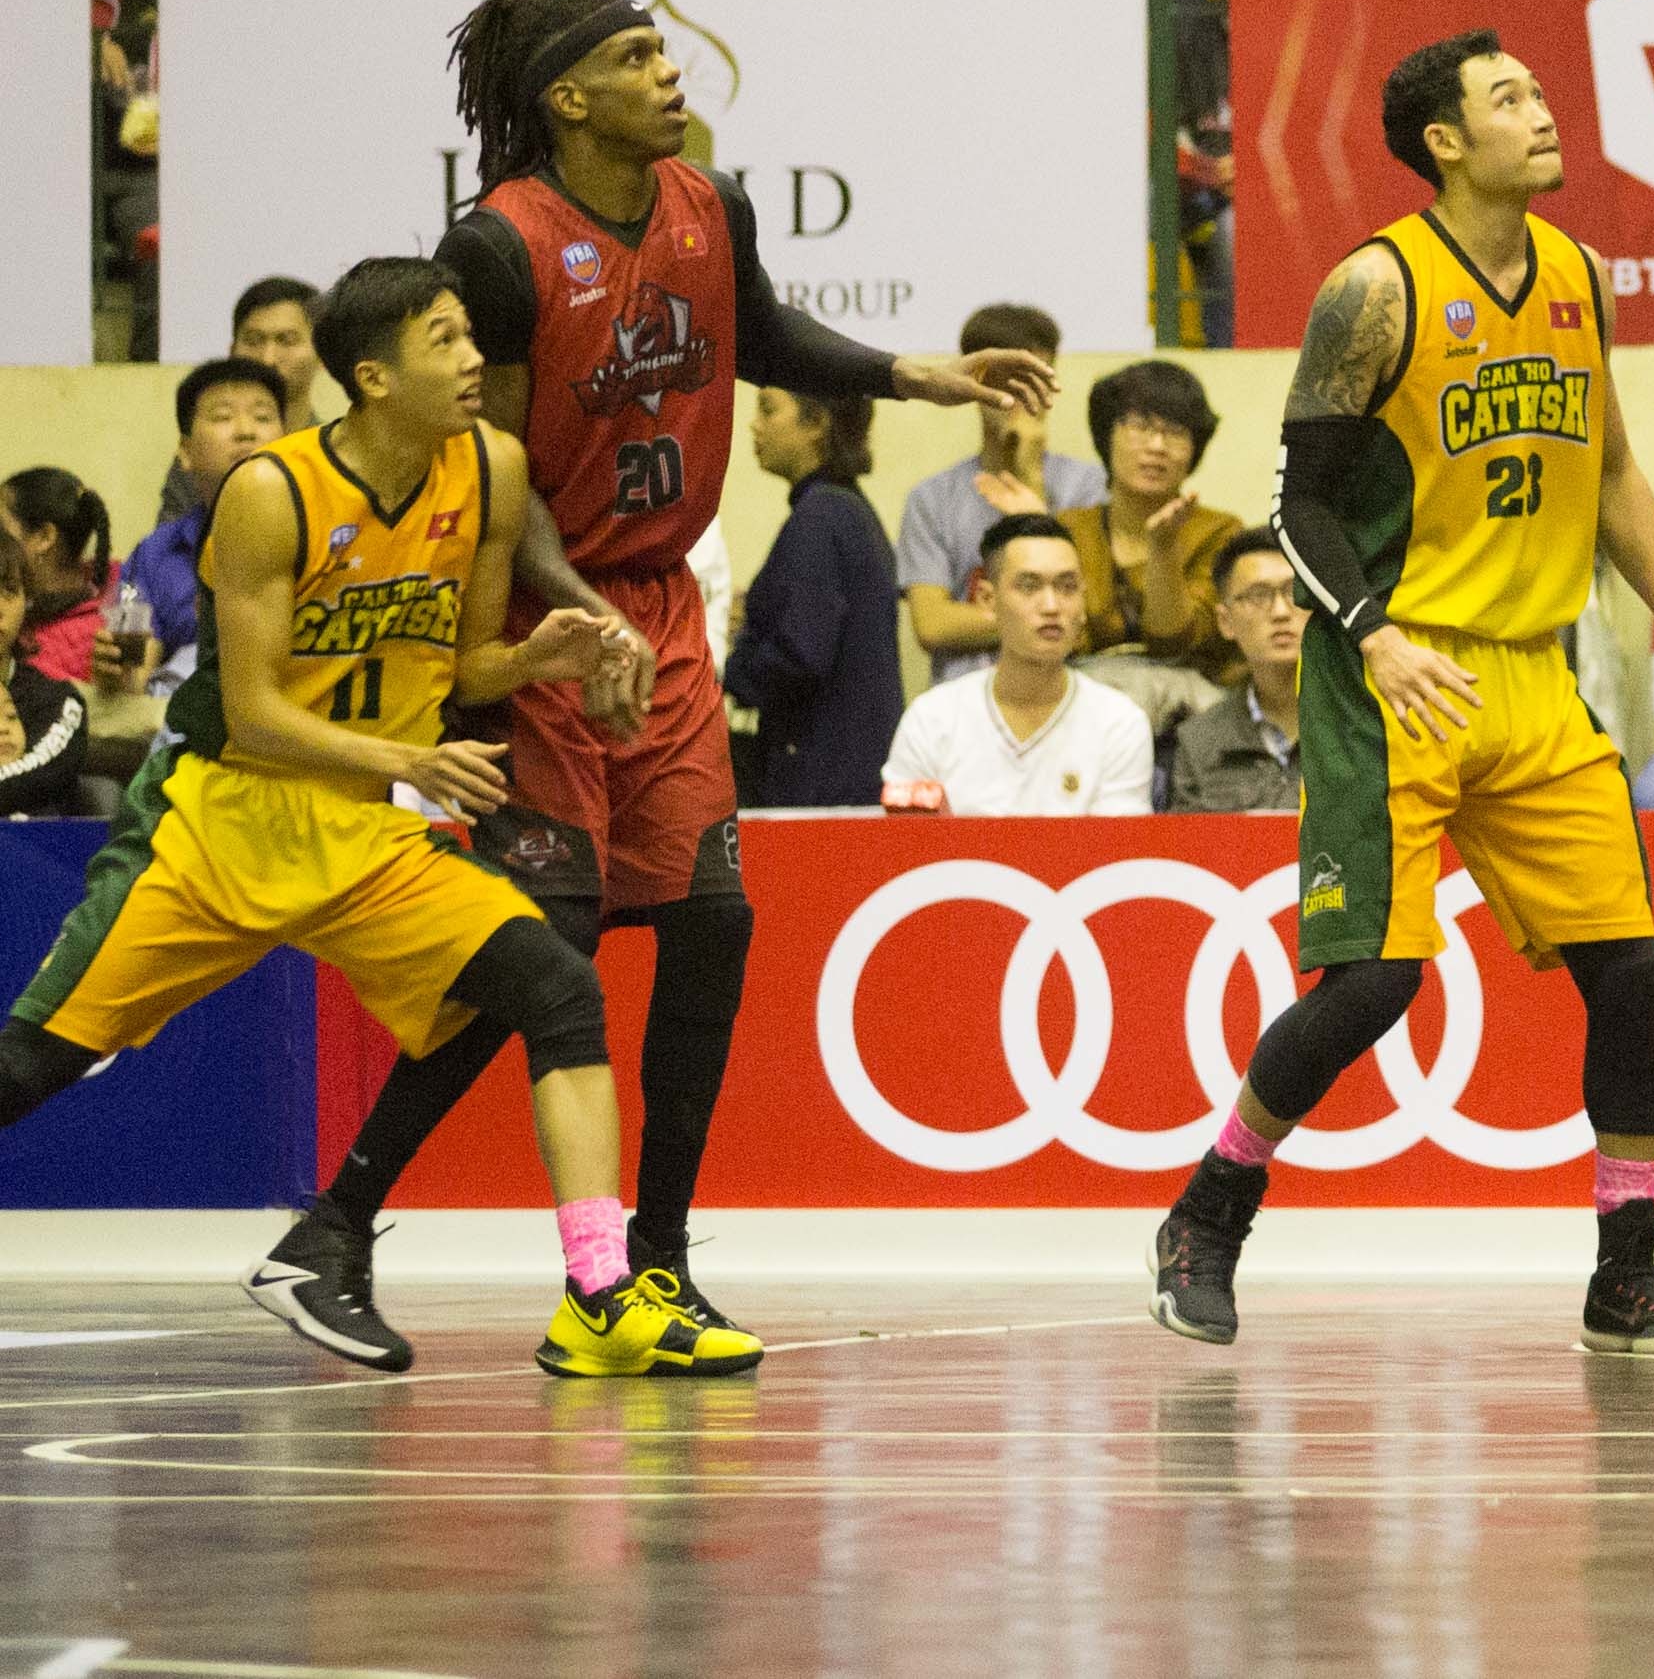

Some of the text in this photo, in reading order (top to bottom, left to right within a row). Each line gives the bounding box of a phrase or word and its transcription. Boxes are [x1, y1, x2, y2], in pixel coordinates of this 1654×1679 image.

[564, 243, 594, 264] VBA
[772, 279, 914, 320] ROUP
[1447, 303, 1474, 319] VBA
[1479, 366, 1516, 389] CAN
[1443, 375, 1588, 452] CATSH
[615, 434, 684, 517] 20
[330, 658, 382, 721] 11
